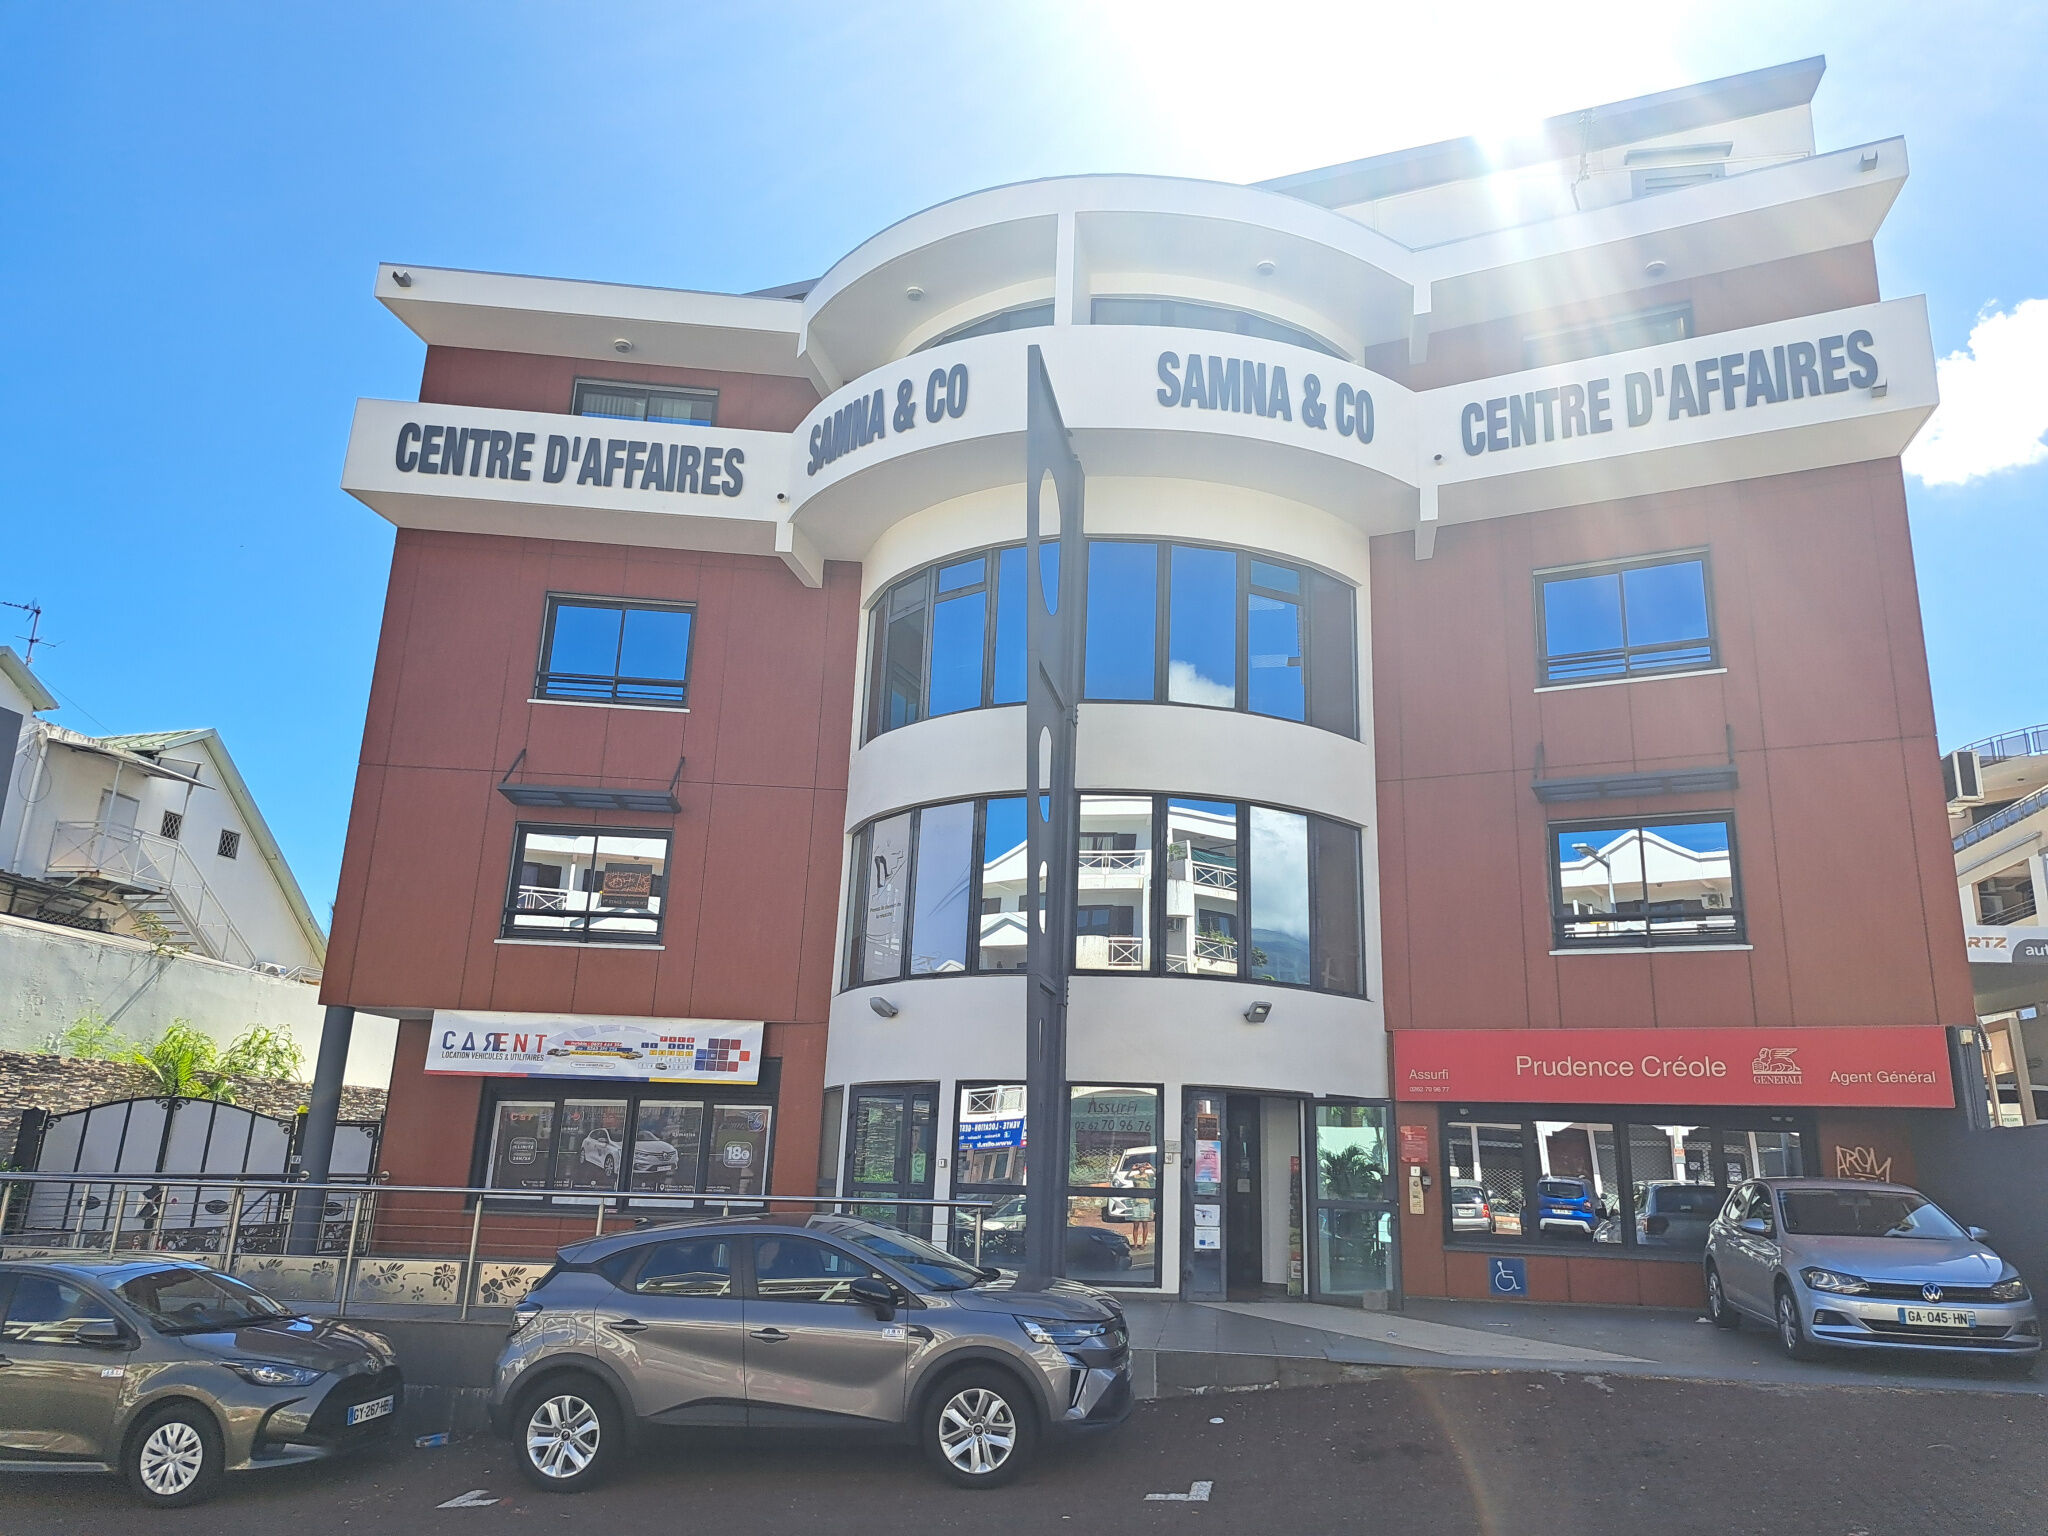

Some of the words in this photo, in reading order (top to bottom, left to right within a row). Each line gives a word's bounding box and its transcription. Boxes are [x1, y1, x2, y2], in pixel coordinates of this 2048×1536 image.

[1155, 350, 1293, 422] SAMNA
[1301, 373, 1328, 431] &
[1334, 382, 1375, 444] CO
[1460, 382, 1615, 457] CENTRE
[1626, 328, 1879, 428] D'AFFAIRES
[806, 387, 886, 476] SAMNA
[892, 378, 916, 430] &
[925, 362, 969, 424] CO
[395, 421, 535, 482] CENTRE
[542, 434, 744, 498] D'AFFAIRES
[441, 1051, 470, 1059] LOCATION
[510, 1054, 545, 1062] UTILITAIRES
[1409, 1069, 1449, 1080] Assurfi
[1516, 1055, 1634, 1077] Prudence
[1641, 1055, 1727, 1077] Créole
[1753, 1076, 1802, 1085] GENERALI
[1829, 1070, 1873, 1086] Agent
[1876, 1069, 1936, 1084] Général
[1074, 1121, 1085, 1130] 02
[1088, 1122, 1099, 1130] 62
[1101, 1119, 1115, 1131] 70
[1119, 1119, 1133, 1131] 96
[1138, 1120, 1152, 1132] 76
[1907, 1310, 1968, 1325] GA-045-HN
